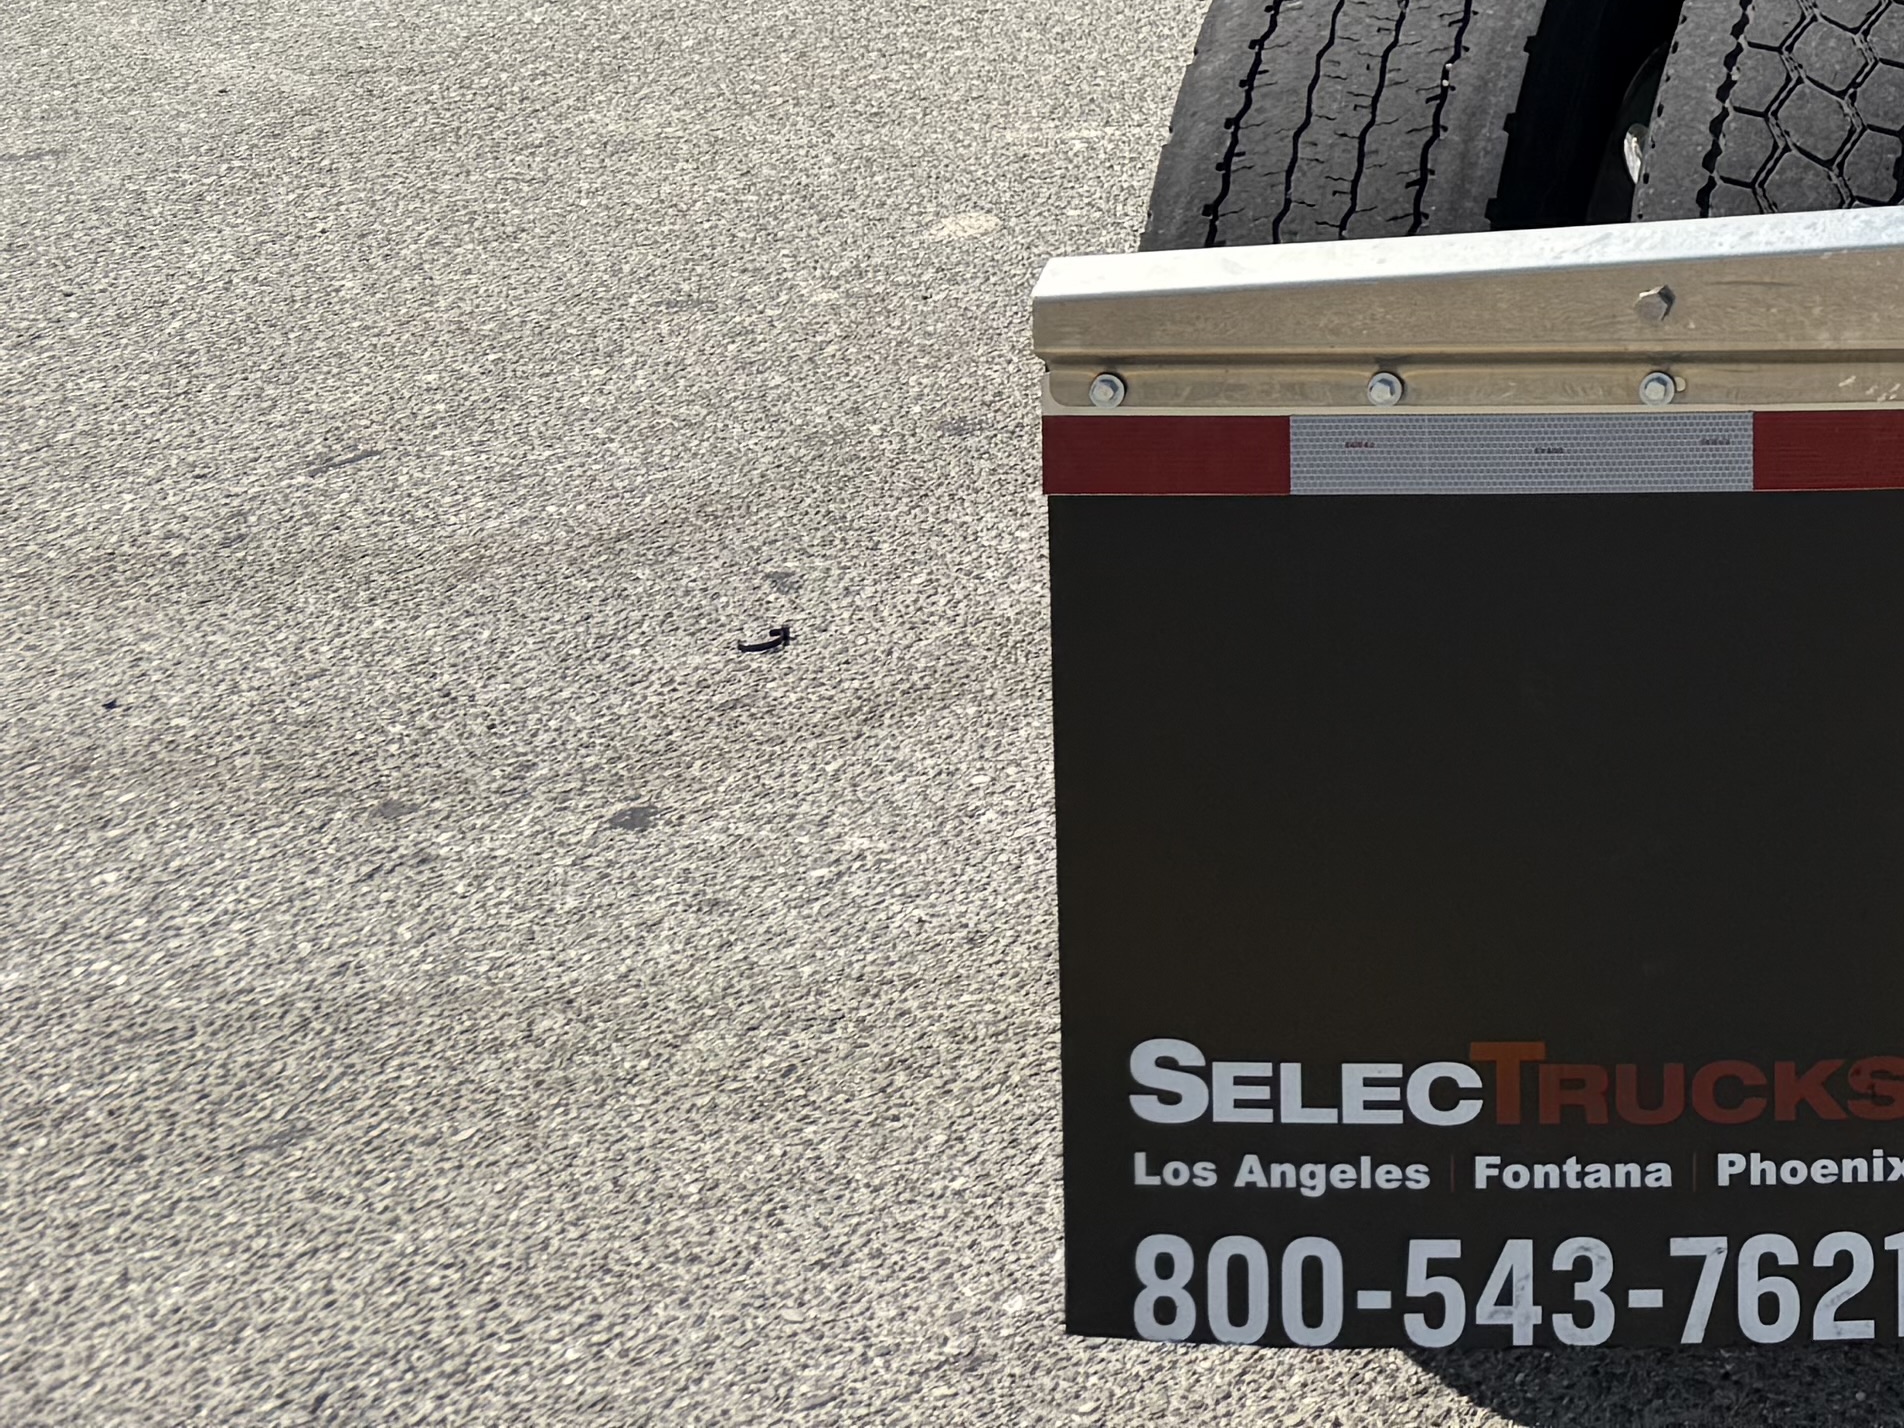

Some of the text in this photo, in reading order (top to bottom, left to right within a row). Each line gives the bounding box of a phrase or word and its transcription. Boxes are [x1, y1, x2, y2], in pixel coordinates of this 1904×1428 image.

[1133, 1151, 1219, 1188] Los
[1234, 1153, 1432, 1198] Angeles
[1474, 1154, 1673, 1190] Fontana
